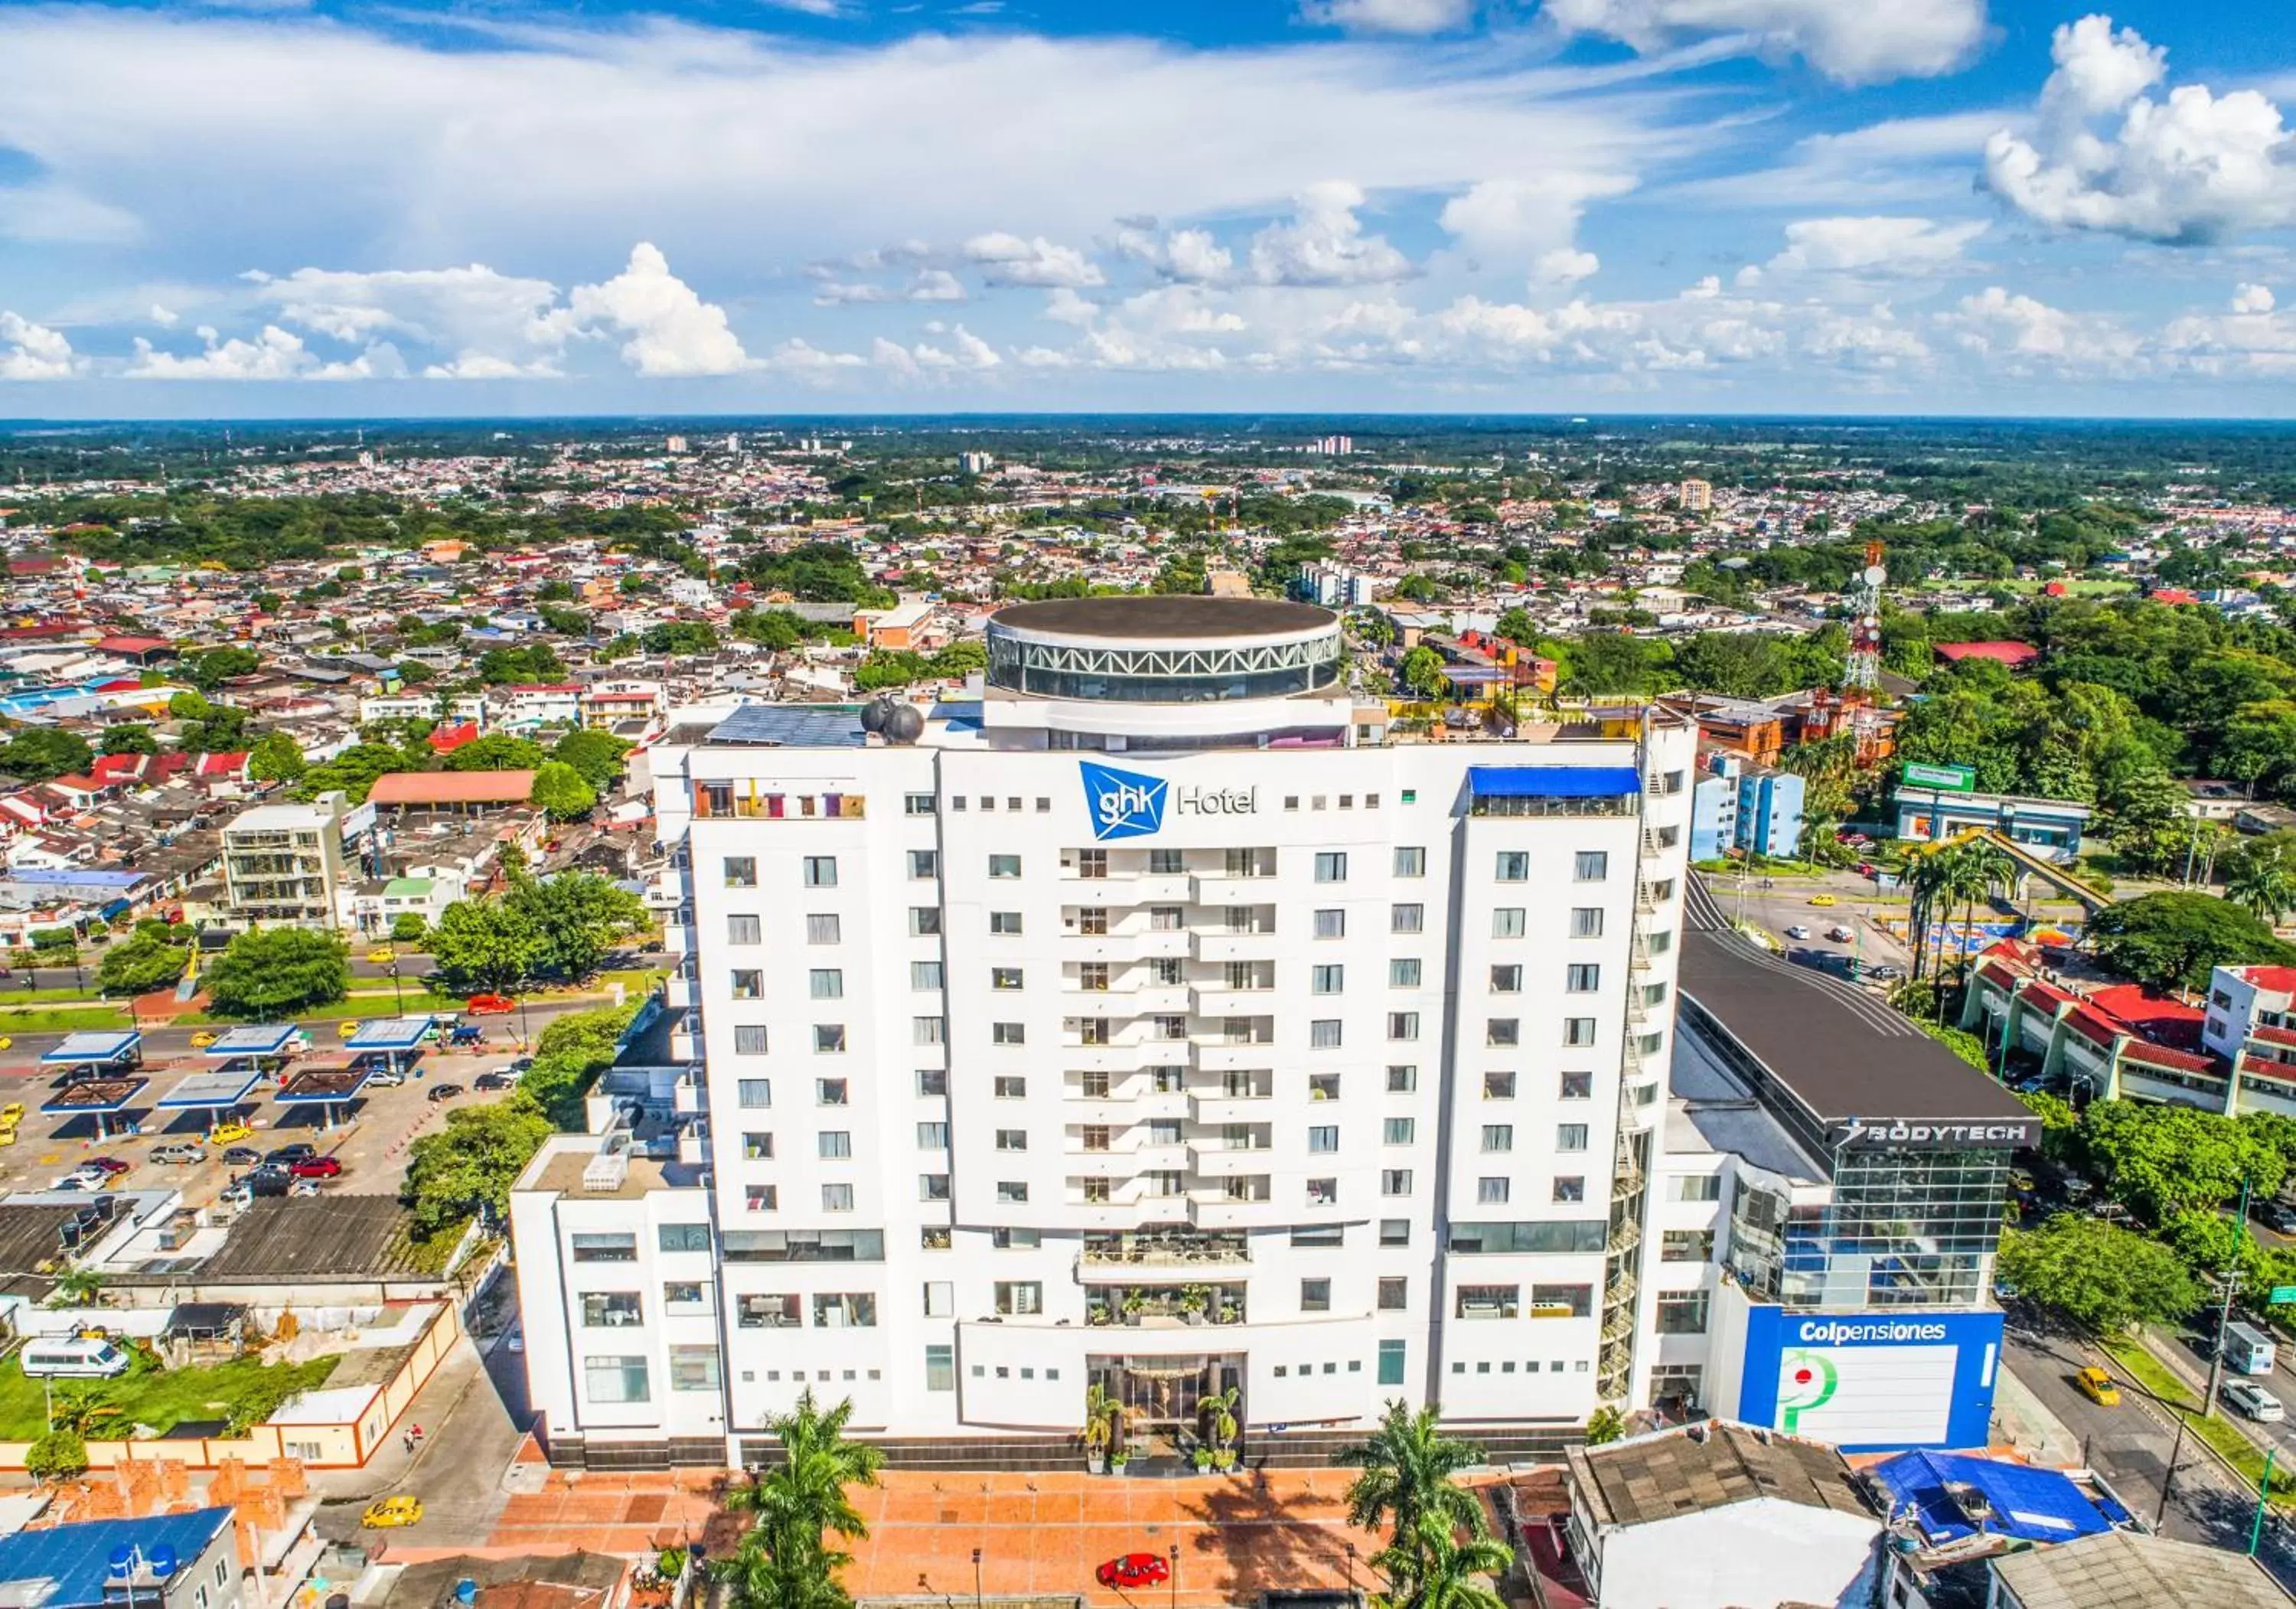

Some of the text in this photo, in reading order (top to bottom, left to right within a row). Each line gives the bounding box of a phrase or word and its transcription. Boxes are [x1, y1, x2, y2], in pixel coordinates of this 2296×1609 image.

[1177, 785, 1259, 814] Hotel
[1867, 1125, 2027, 1141] BODYTECH
[1799, 1321, 1947, 1345] Colpensiones
